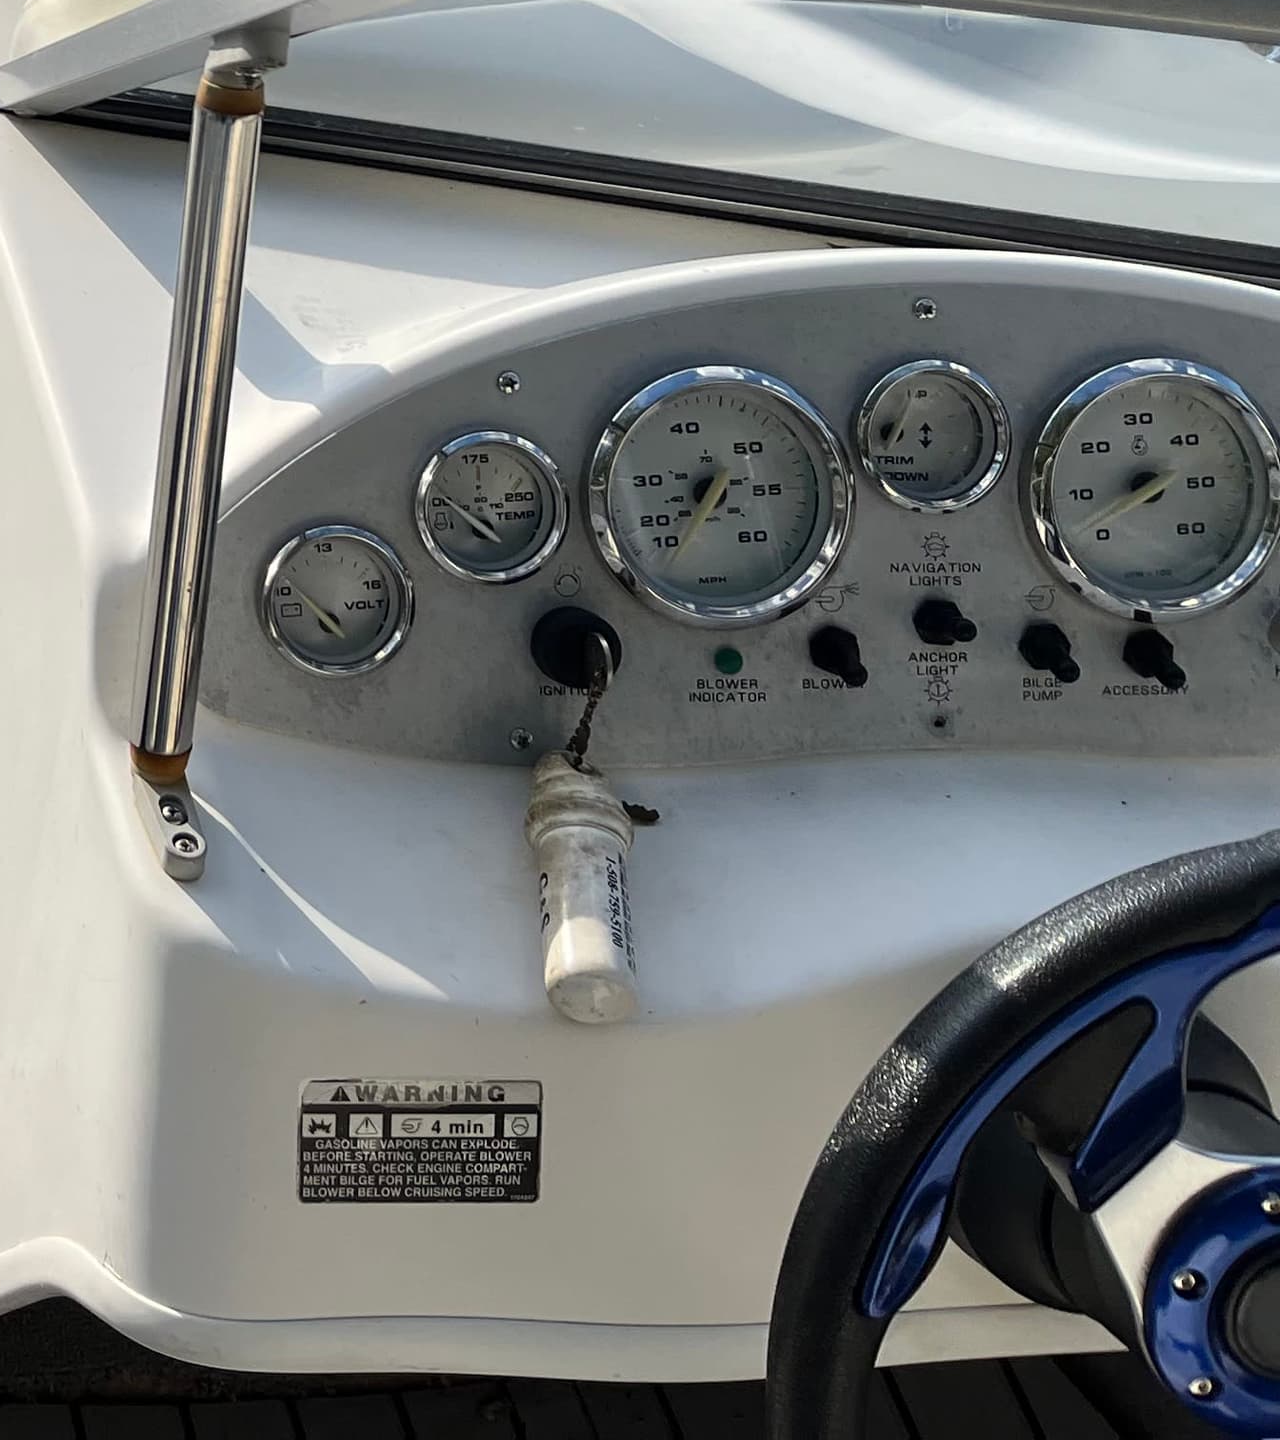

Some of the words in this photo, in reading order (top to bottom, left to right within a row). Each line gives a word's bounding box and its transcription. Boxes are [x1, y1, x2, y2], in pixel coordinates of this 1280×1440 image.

[1123, 413, 1153, 425] 30
[670, 422, 700, 434] 40
[1169, 434, 1200, 446] 40
[733, 441, 763, 454] 50
[1081, 441, 1111, 454] 20
[461, 453, 489, 464] 175
[875, 455, 914, 465] TRIM
[633, 474, 663, 487] 30
[1186, 476, 1216, 489] 50
[752, 484, 782, 497] 55
[1069, 488, 1094, 501] 10
[504, 491, 534, 503] 250
[496, 510, 536, 521] TEMP
[640, 515, 671, 527] 20
[1095, 528, 1111, 541] 0
[1177, 522, 1206, 535] 60
[652, 535, 679, 548] 10
[738, 530, 768, 543] 60
[313, 543, 333, 554] 13
[889, 562, 982, 573] NAVIGATION
[362, 579, 382, 591] 16
[698, 576, 728, 585] MPH
[909, 575, 962, 586] LIGHTS
[276, 586, 292, 597] 10
[343, 599, 385, 611] VOLT
[908, 651, 968, 663] ANCHOR
[916, 664, 959, 676] LIGHT
[696, 678, 759, 690] BLOWER
[802, 678, 864, 690] BLOW
[1022, 677, 1062, 688] BILGE
[688, 691, 767, 703] INDICATOR
[1022, 690, 1063, 701] PUMP
[355, 1085, 505, 1102] WARNING
[431, 1120, 441, 1134] 4
[449, 1119, 484, 1134] min
[315, 1139, 377, 1150] GASOLINE
[380, 1139, 429, 1150] VAPORS
[431, 1139, 457, 1150] CAN
[302, 1151, 352, 1162] BEFORE
[420, 1151, 477, 1162] OPERATE
[479, 1151, 532, 1162] BLOWER
[303, 1163, 310, 1174] 4
[372, 1163, 415, 1174] CHECK
[417, 1163, 462, 1174] ENGINE
[465, 1163, 528, 1174] COMPART-
[303, 1175, 337, 1186] MENT
[339, 1175, 375, 1186] BILGE
[379, 1175, 403, 1186] FOR
[406, 1175, 438, 1186] FUEL
[495, 1175, 521, 1186] RUN
[302, 1186, 354, 1197] BLOWER
[357, 1186, 402, 1197] BELOW
[404, 1186, 462, 1197] CRUISING
